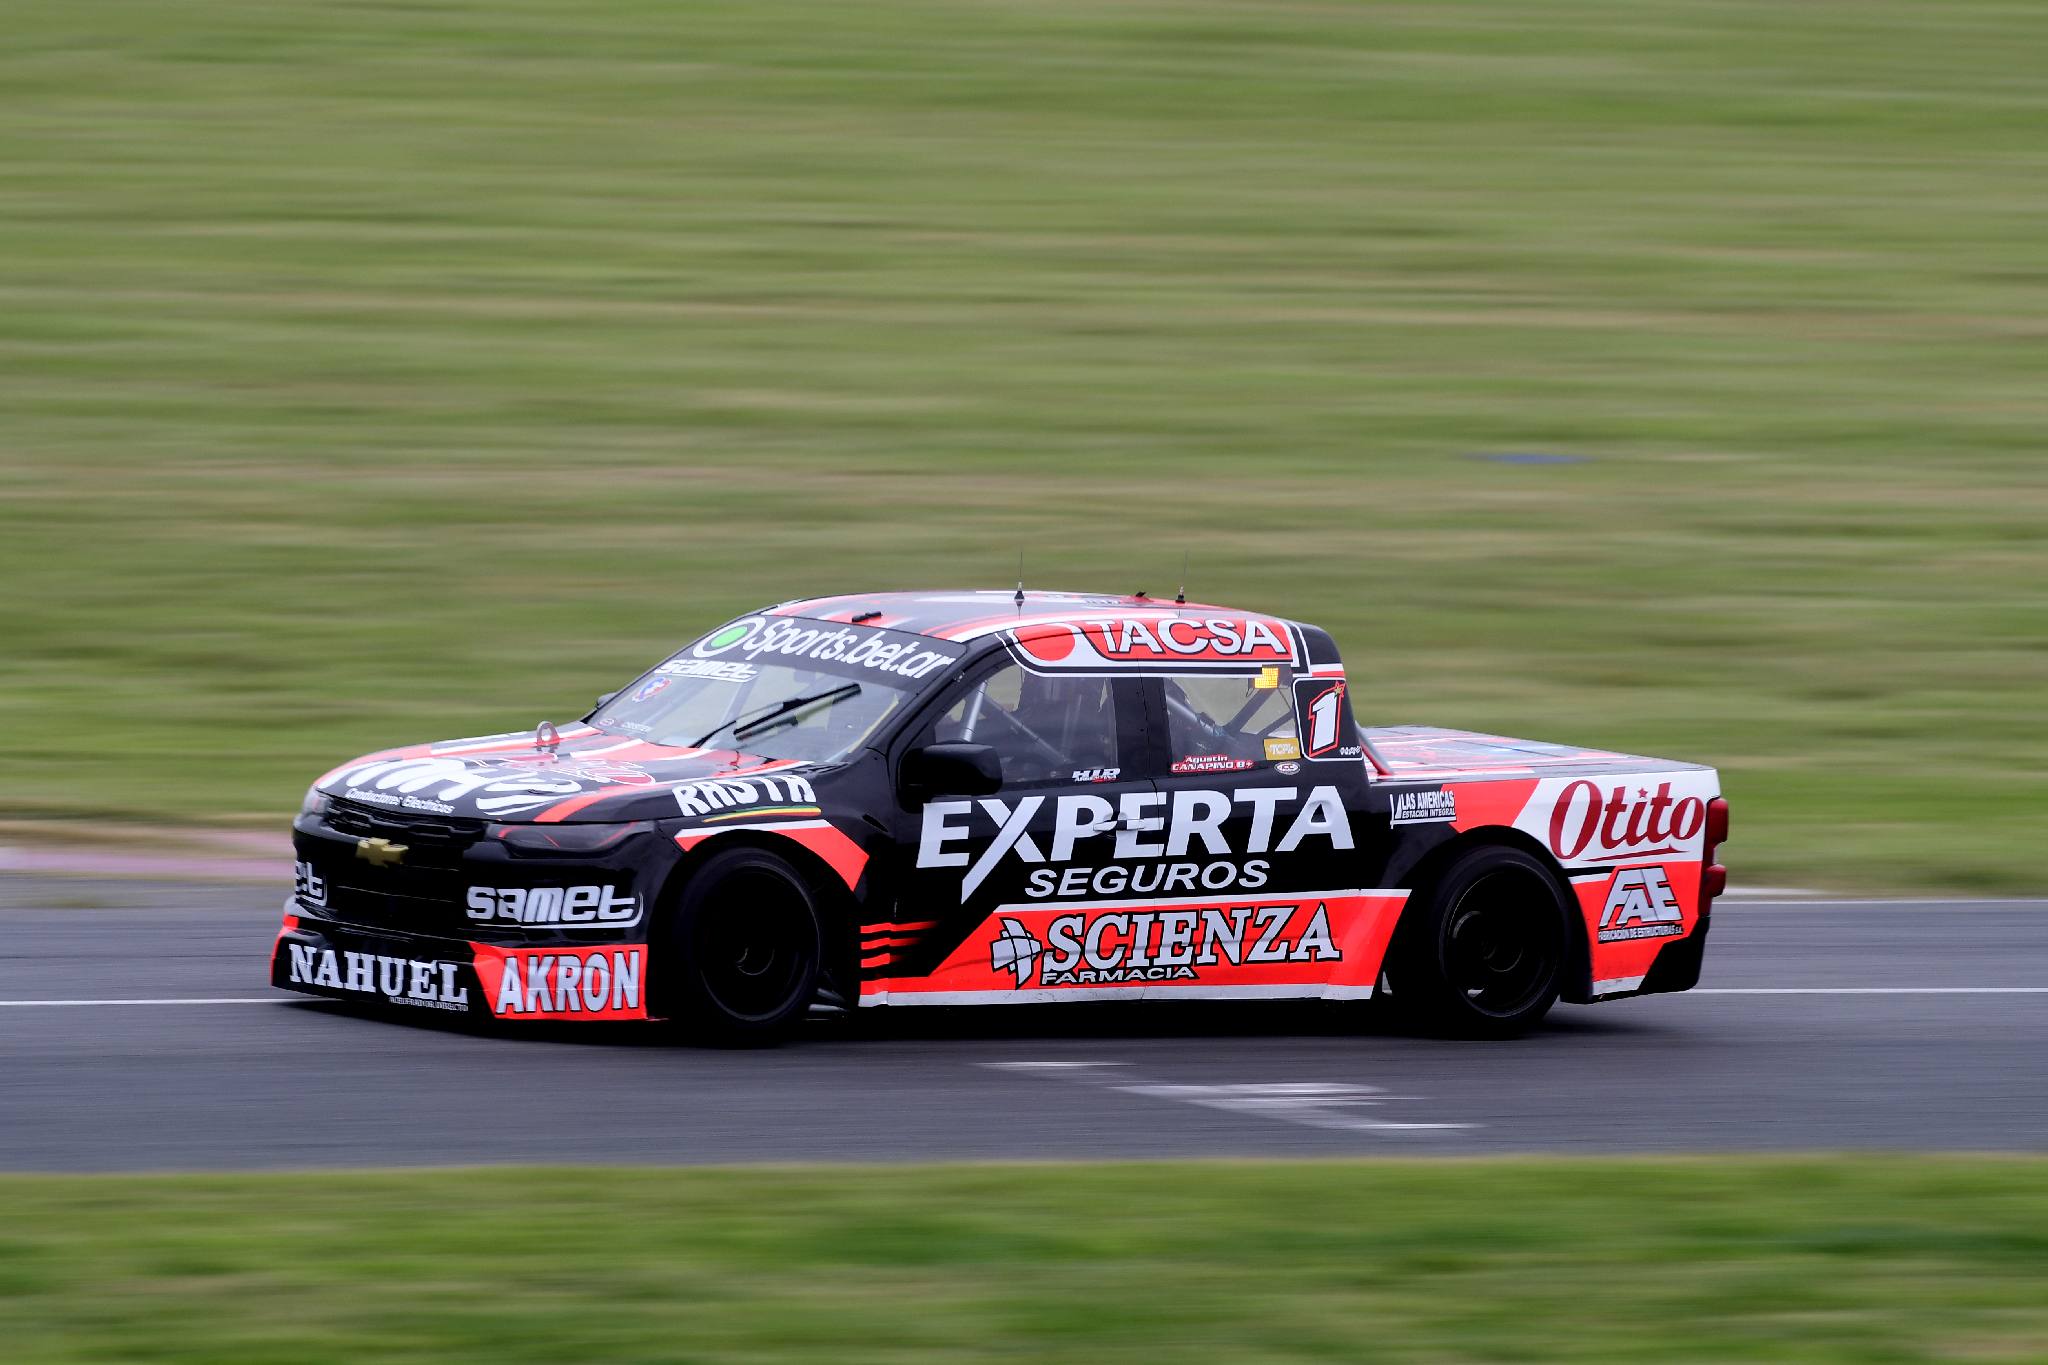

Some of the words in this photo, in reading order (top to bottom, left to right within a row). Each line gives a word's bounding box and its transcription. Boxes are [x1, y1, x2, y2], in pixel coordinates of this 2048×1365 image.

[749, 617, 955, 679] Sports.bet.ar
[1085, 618, 1288, 655] TACSA
[654, 659, 758, 682] samet
[1308, 685, 1342, 757] 1
[1401, 792, 1416, 811] LAS
[1417, 790, 1455, 810] AMERICAS
[1549, 779, 1706, 860] Otito
[916, 785, 1356, 905] EXPERTA
[466, 884, 637, 923] samet
[1024, 860, 1270, 898] SEGUROS
[1599, 866, 1684, 927] FAE
[1043, 902, 1344, 973] SCIENZA
[288, 943, 469, 1004] NAHUEL
[495, 950, 640, 1015] AKRON
[1040, 965, 1199, 986] FARMACIA
